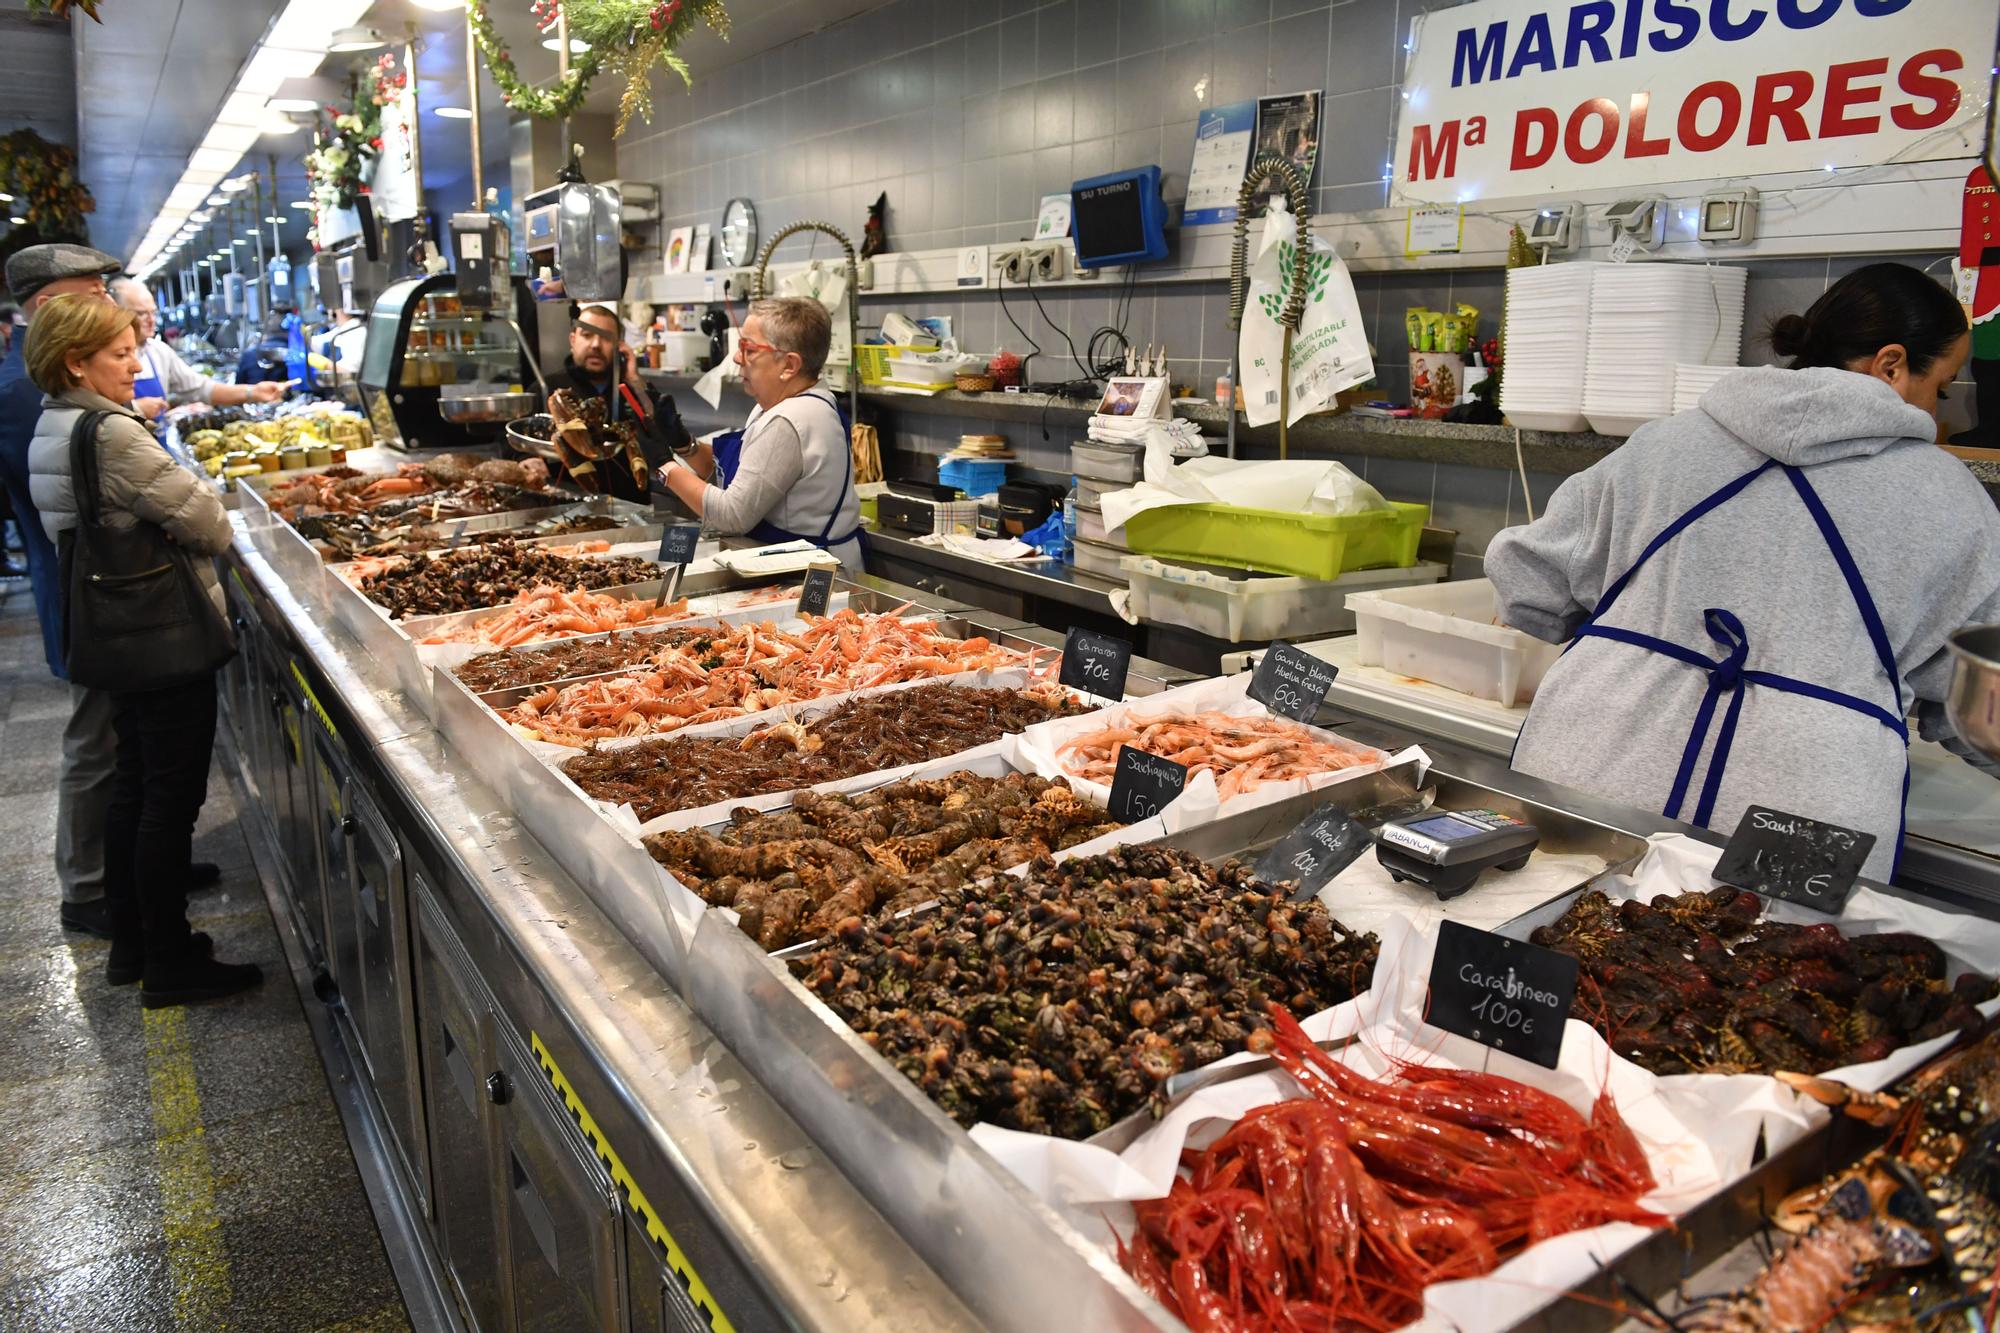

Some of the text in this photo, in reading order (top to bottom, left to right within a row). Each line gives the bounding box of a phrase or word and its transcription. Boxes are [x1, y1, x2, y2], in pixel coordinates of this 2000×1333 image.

[1451, 0, 1912, 88] MARISC
[1509, 48, 1964, 172] DOLORES
[1080, 182, 1131, 200] SU TURNO
[1084, 658, 1110, 680] 70€
[1275, 650, 1305, 672] Gamba
[1274, 684, 1302, 709] 60€
[1291, 848, 1319, 876] 100€
[1460, 963, 1559, 1008] Carabinero
[1471, 994, 1535, 1034] 100€
